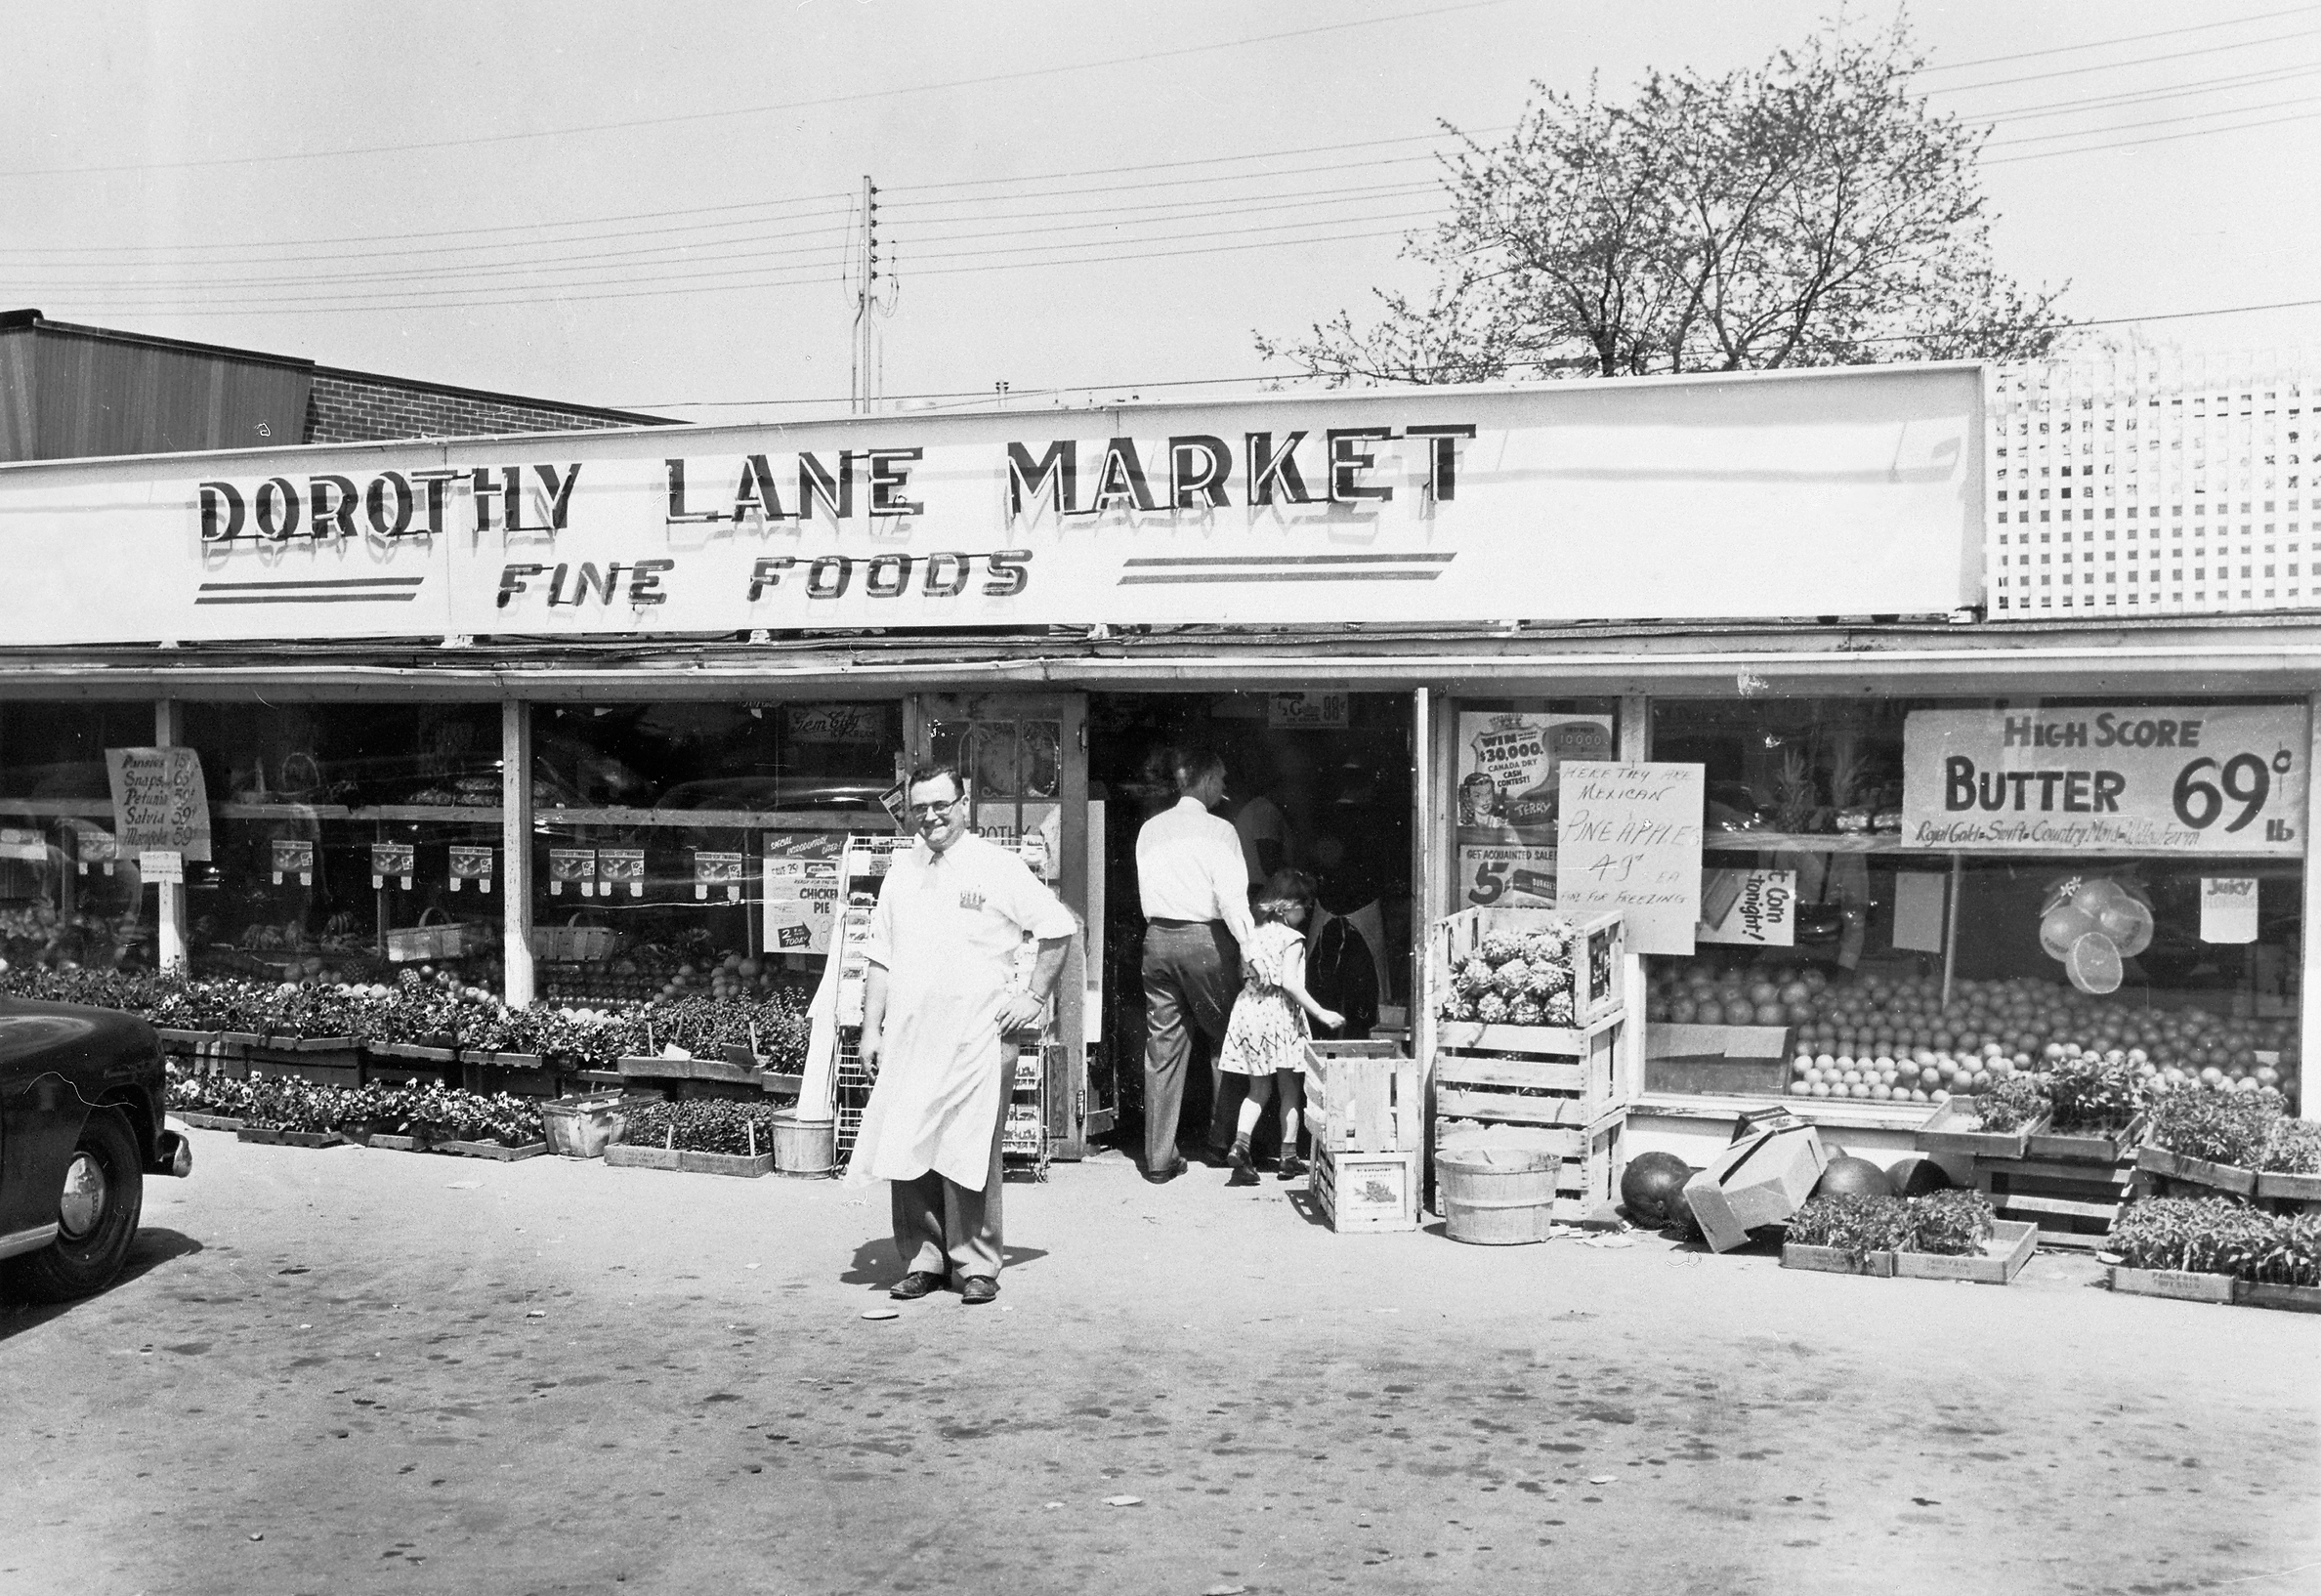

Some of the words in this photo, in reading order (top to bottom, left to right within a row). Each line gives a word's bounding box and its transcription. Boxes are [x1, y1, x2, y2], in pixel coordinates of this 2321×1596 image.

[199, 463, 582, 541] DOROTHY
[665, 447, 924, 523] LANE
[1007, 424, 1476, 518] MARKET
[496, 559, 675, 609] FINE
[747, 550, 1033, 602] FOODS
[2004, 715, 2089, 747] HIGH
[2095, 712, 2204, 748] SCORE
[1481, 733, 1517, 747] WIN
[1488, 761, 1521, 772] CANADA
[1503, 770, 1523, 778] CASH
[1562, 767, 1611, 779] HERE
[1617, 767, 1650, 782] THEY
[1662, 770, 1693, 780] ARE
[1497, 776, 1531, 787] CONTEST!
[1945, 755, 2127, 813] BUTTER
[1578, 783, 1675, 801] MEXICAN
[125, 806, 164, 824] Salvia
[1514, 803, 1552, 817] TERRY
[1466, 849, 1482, 860] GET
[1483, 849, 1532, 861] ACQUAINTED
[1587, 891, 1608, 902] FOR
[1615, 890, 1685, 904] FREEZING
[814, 902, 830, 913] PIE
[1739, 874, 1766, 942] tonight!
[1766, 887, 1790, 923] Corn
[781, 929, 792, 939] 2
[784, 937, 809, 945] TODAY
